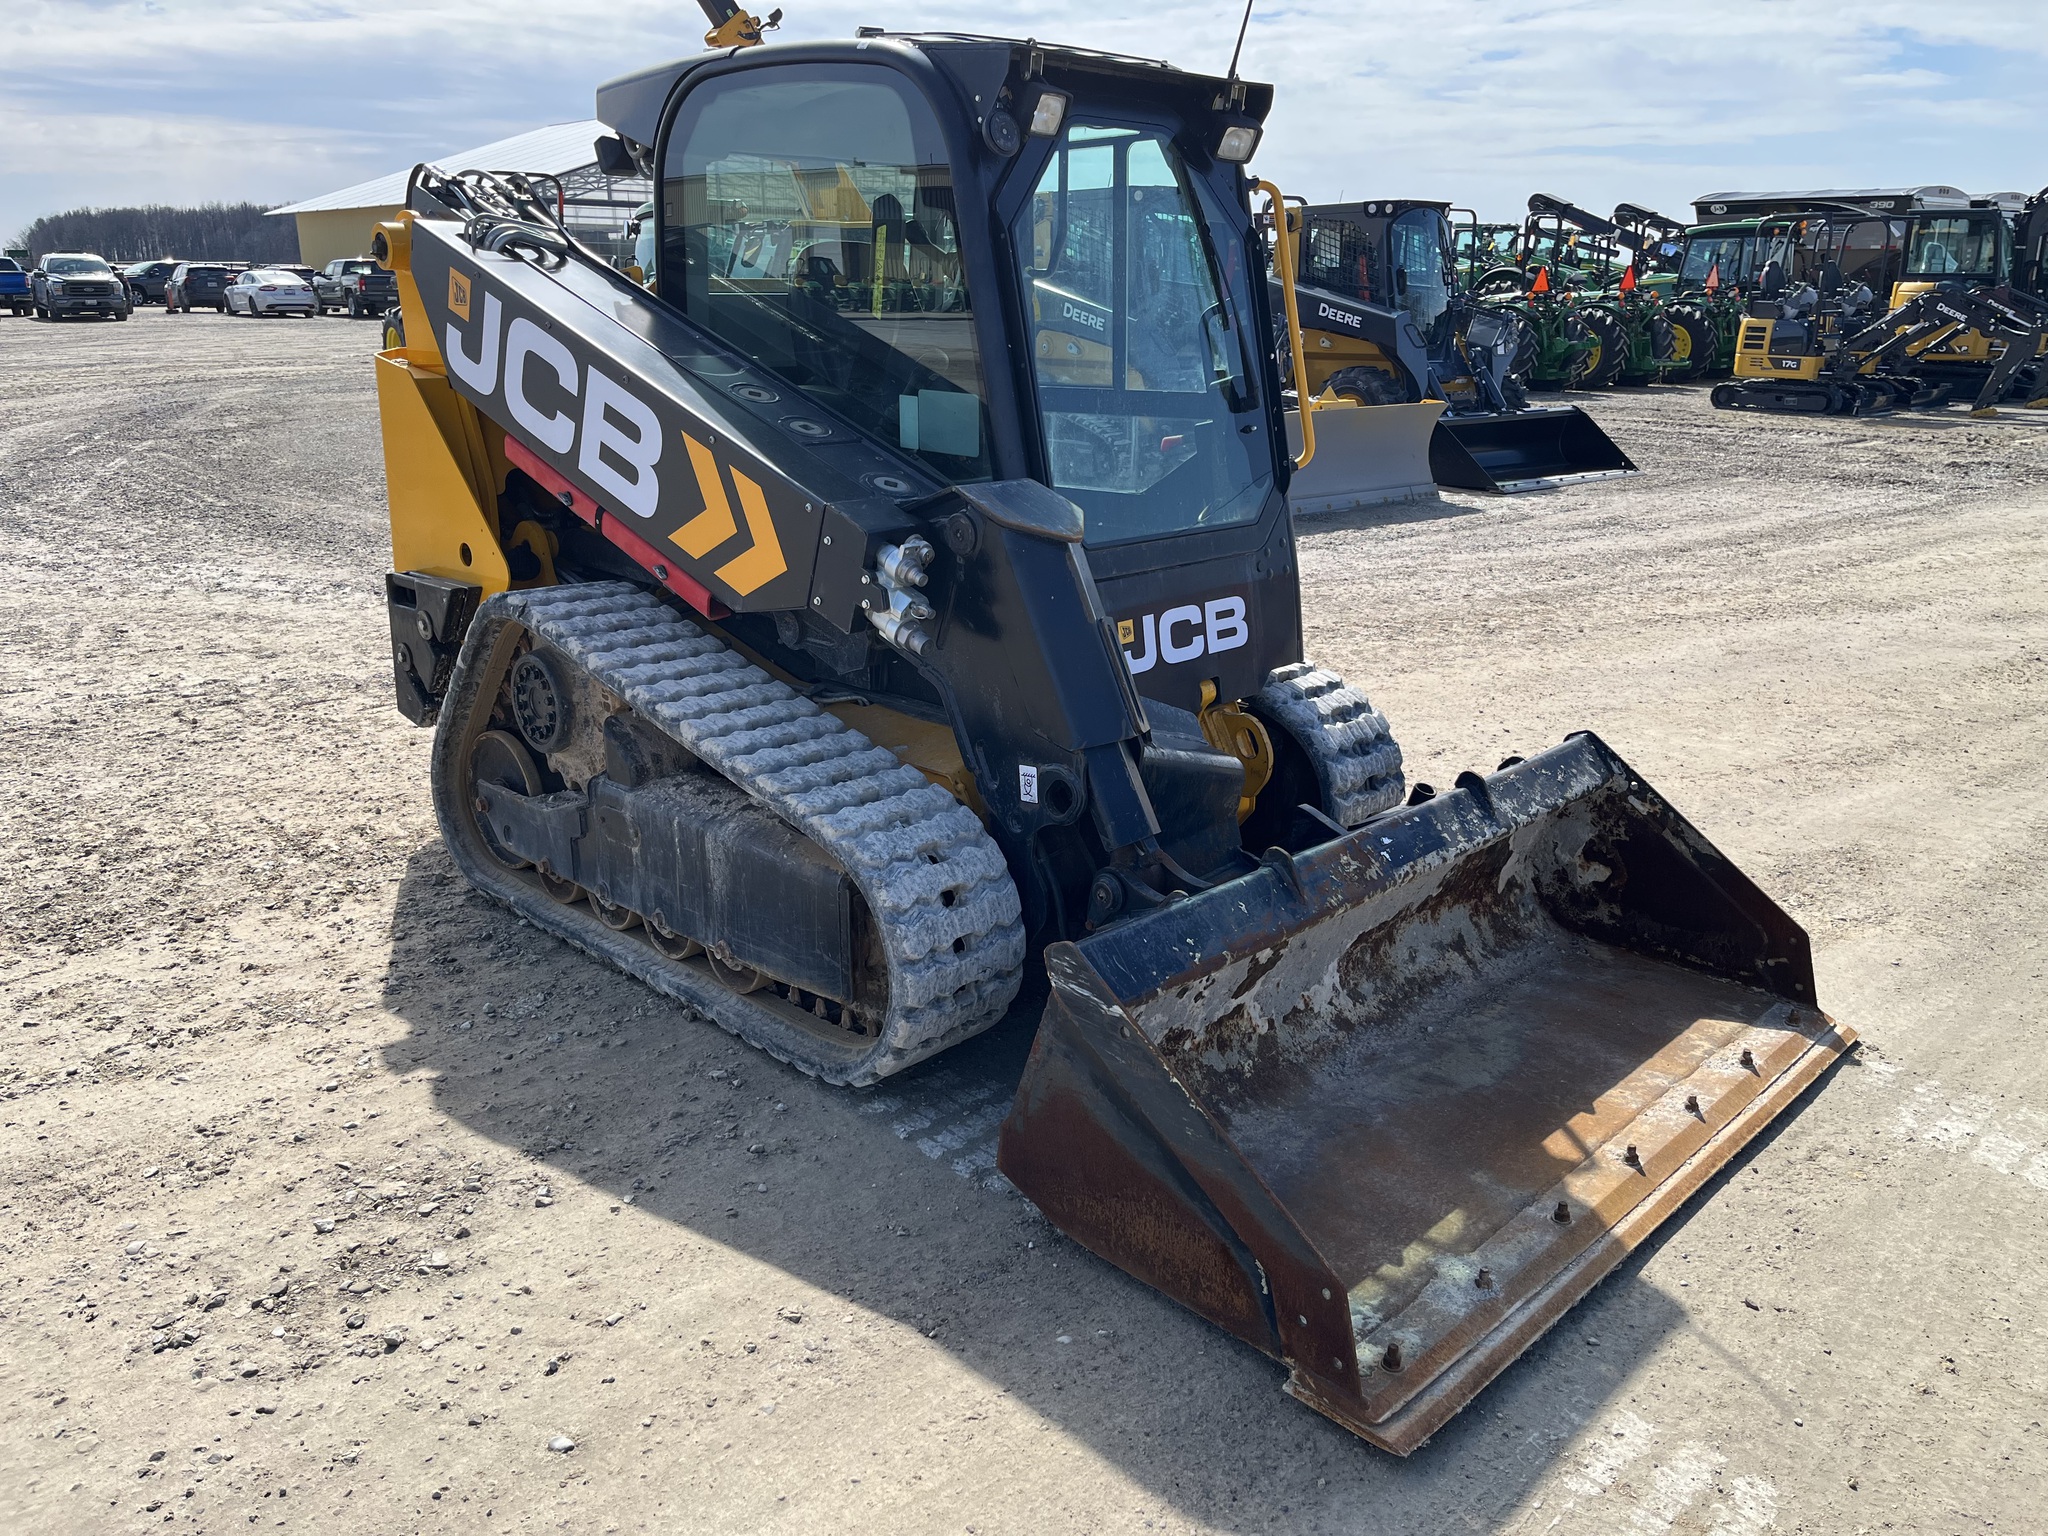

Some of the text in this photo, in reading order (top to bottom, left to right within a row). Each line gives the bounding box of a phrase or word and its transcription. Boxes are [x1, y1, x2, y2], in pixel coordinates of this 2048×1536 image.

[1870, 201, 1895, 209] 390
[453, 279, 467, 305] JCB
[1063, 302, 1105, 331] DEERE
[1318, 303, 1362, 328] DEERE
[1936, 302, 1968, 322] DEERE
[1782, 360, 1797, 368] 17G
[446, 291, 663, 518] JCB
[1123, 595, 1249, 675] JCB
